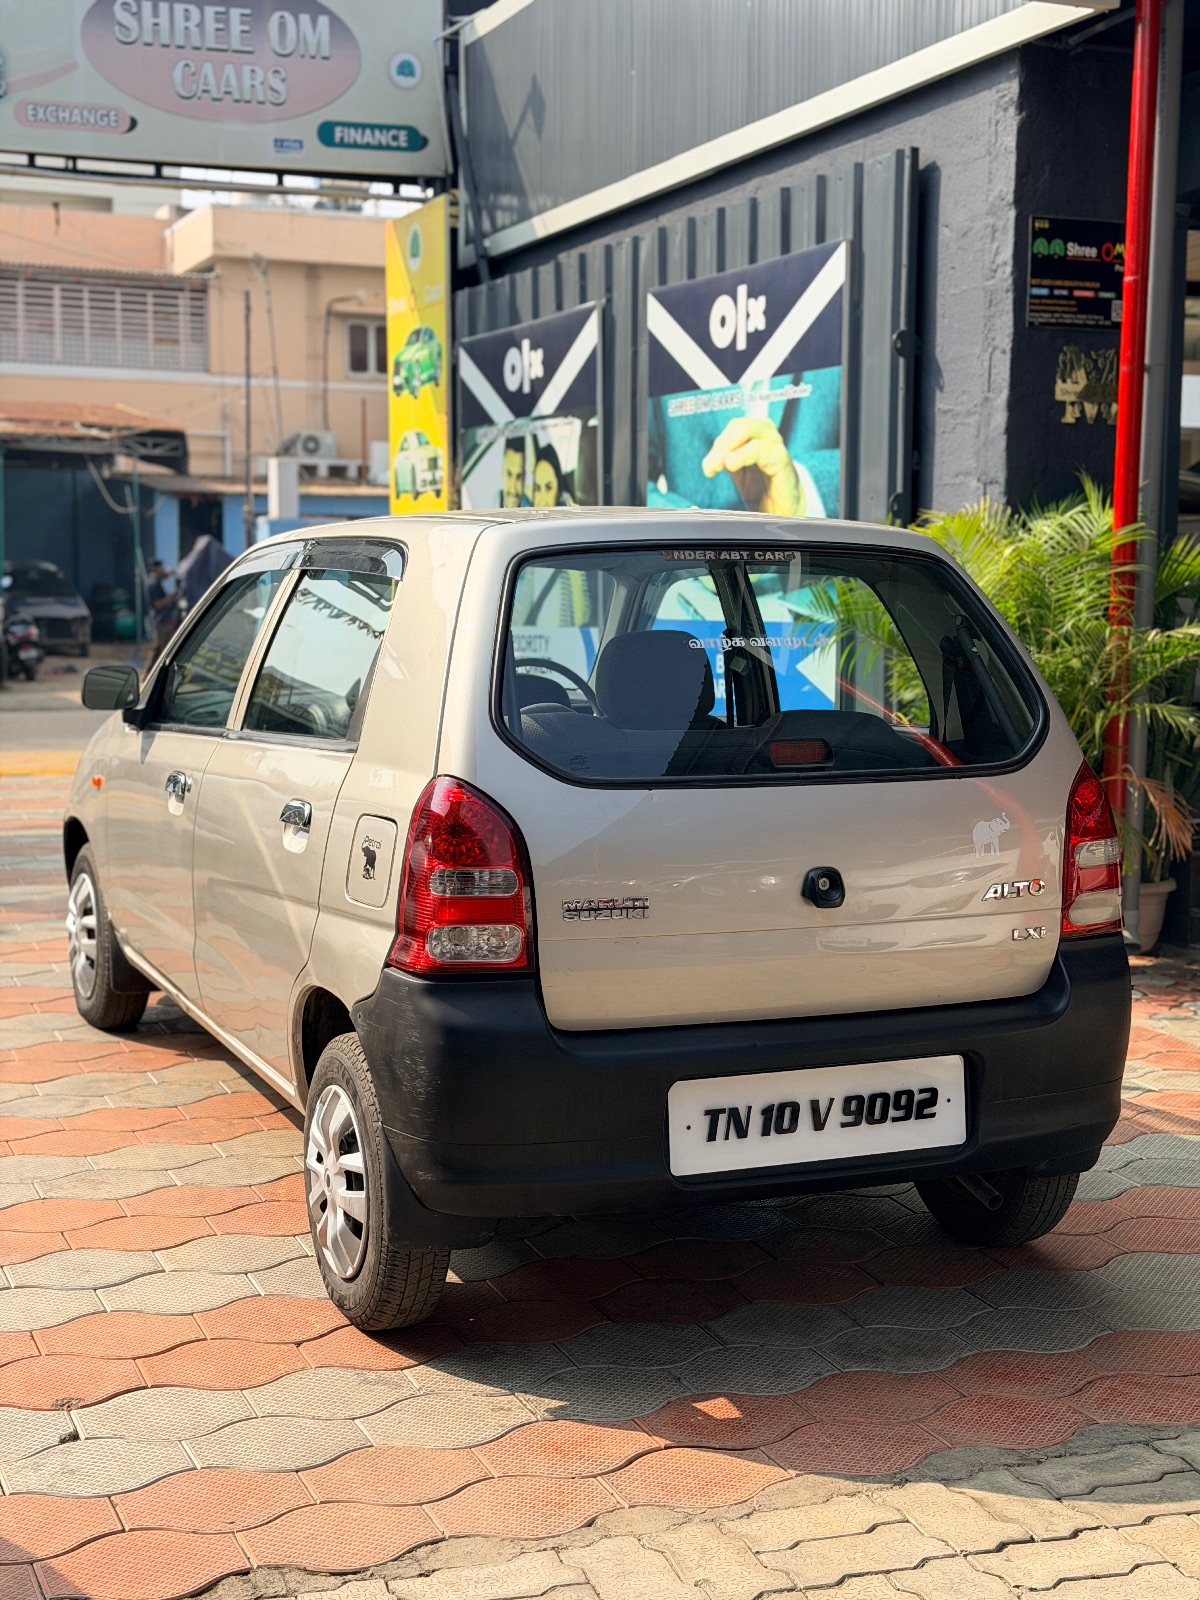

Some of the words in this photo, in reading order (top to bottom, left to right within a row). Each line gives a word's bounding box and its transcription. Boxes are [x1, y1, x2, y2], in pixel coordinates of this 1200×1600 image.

[113, 0, 254, 54] SHREE
[267, 10, 331, 60] OM
[172, 58, 288, 106] CAARS
[25, 103, 120, 128] EXCHANGE
[333, 125, 409, 147] FINANCE
[1066, 241, 1098, 258] Shree
[688, 633, 746, 651] வாழ்க
[981, 879, 1046, 901] ALTO
[562, 897, 649, 910] MARUTI
[563, 908, 650, 921] SUZUKI
[704, 1105, 752, 1142] TN
[760, 1101, 800, 1137] 10
[810, 1097, 835, 1132] V
[840, 1087, 939, 1128] 9092
